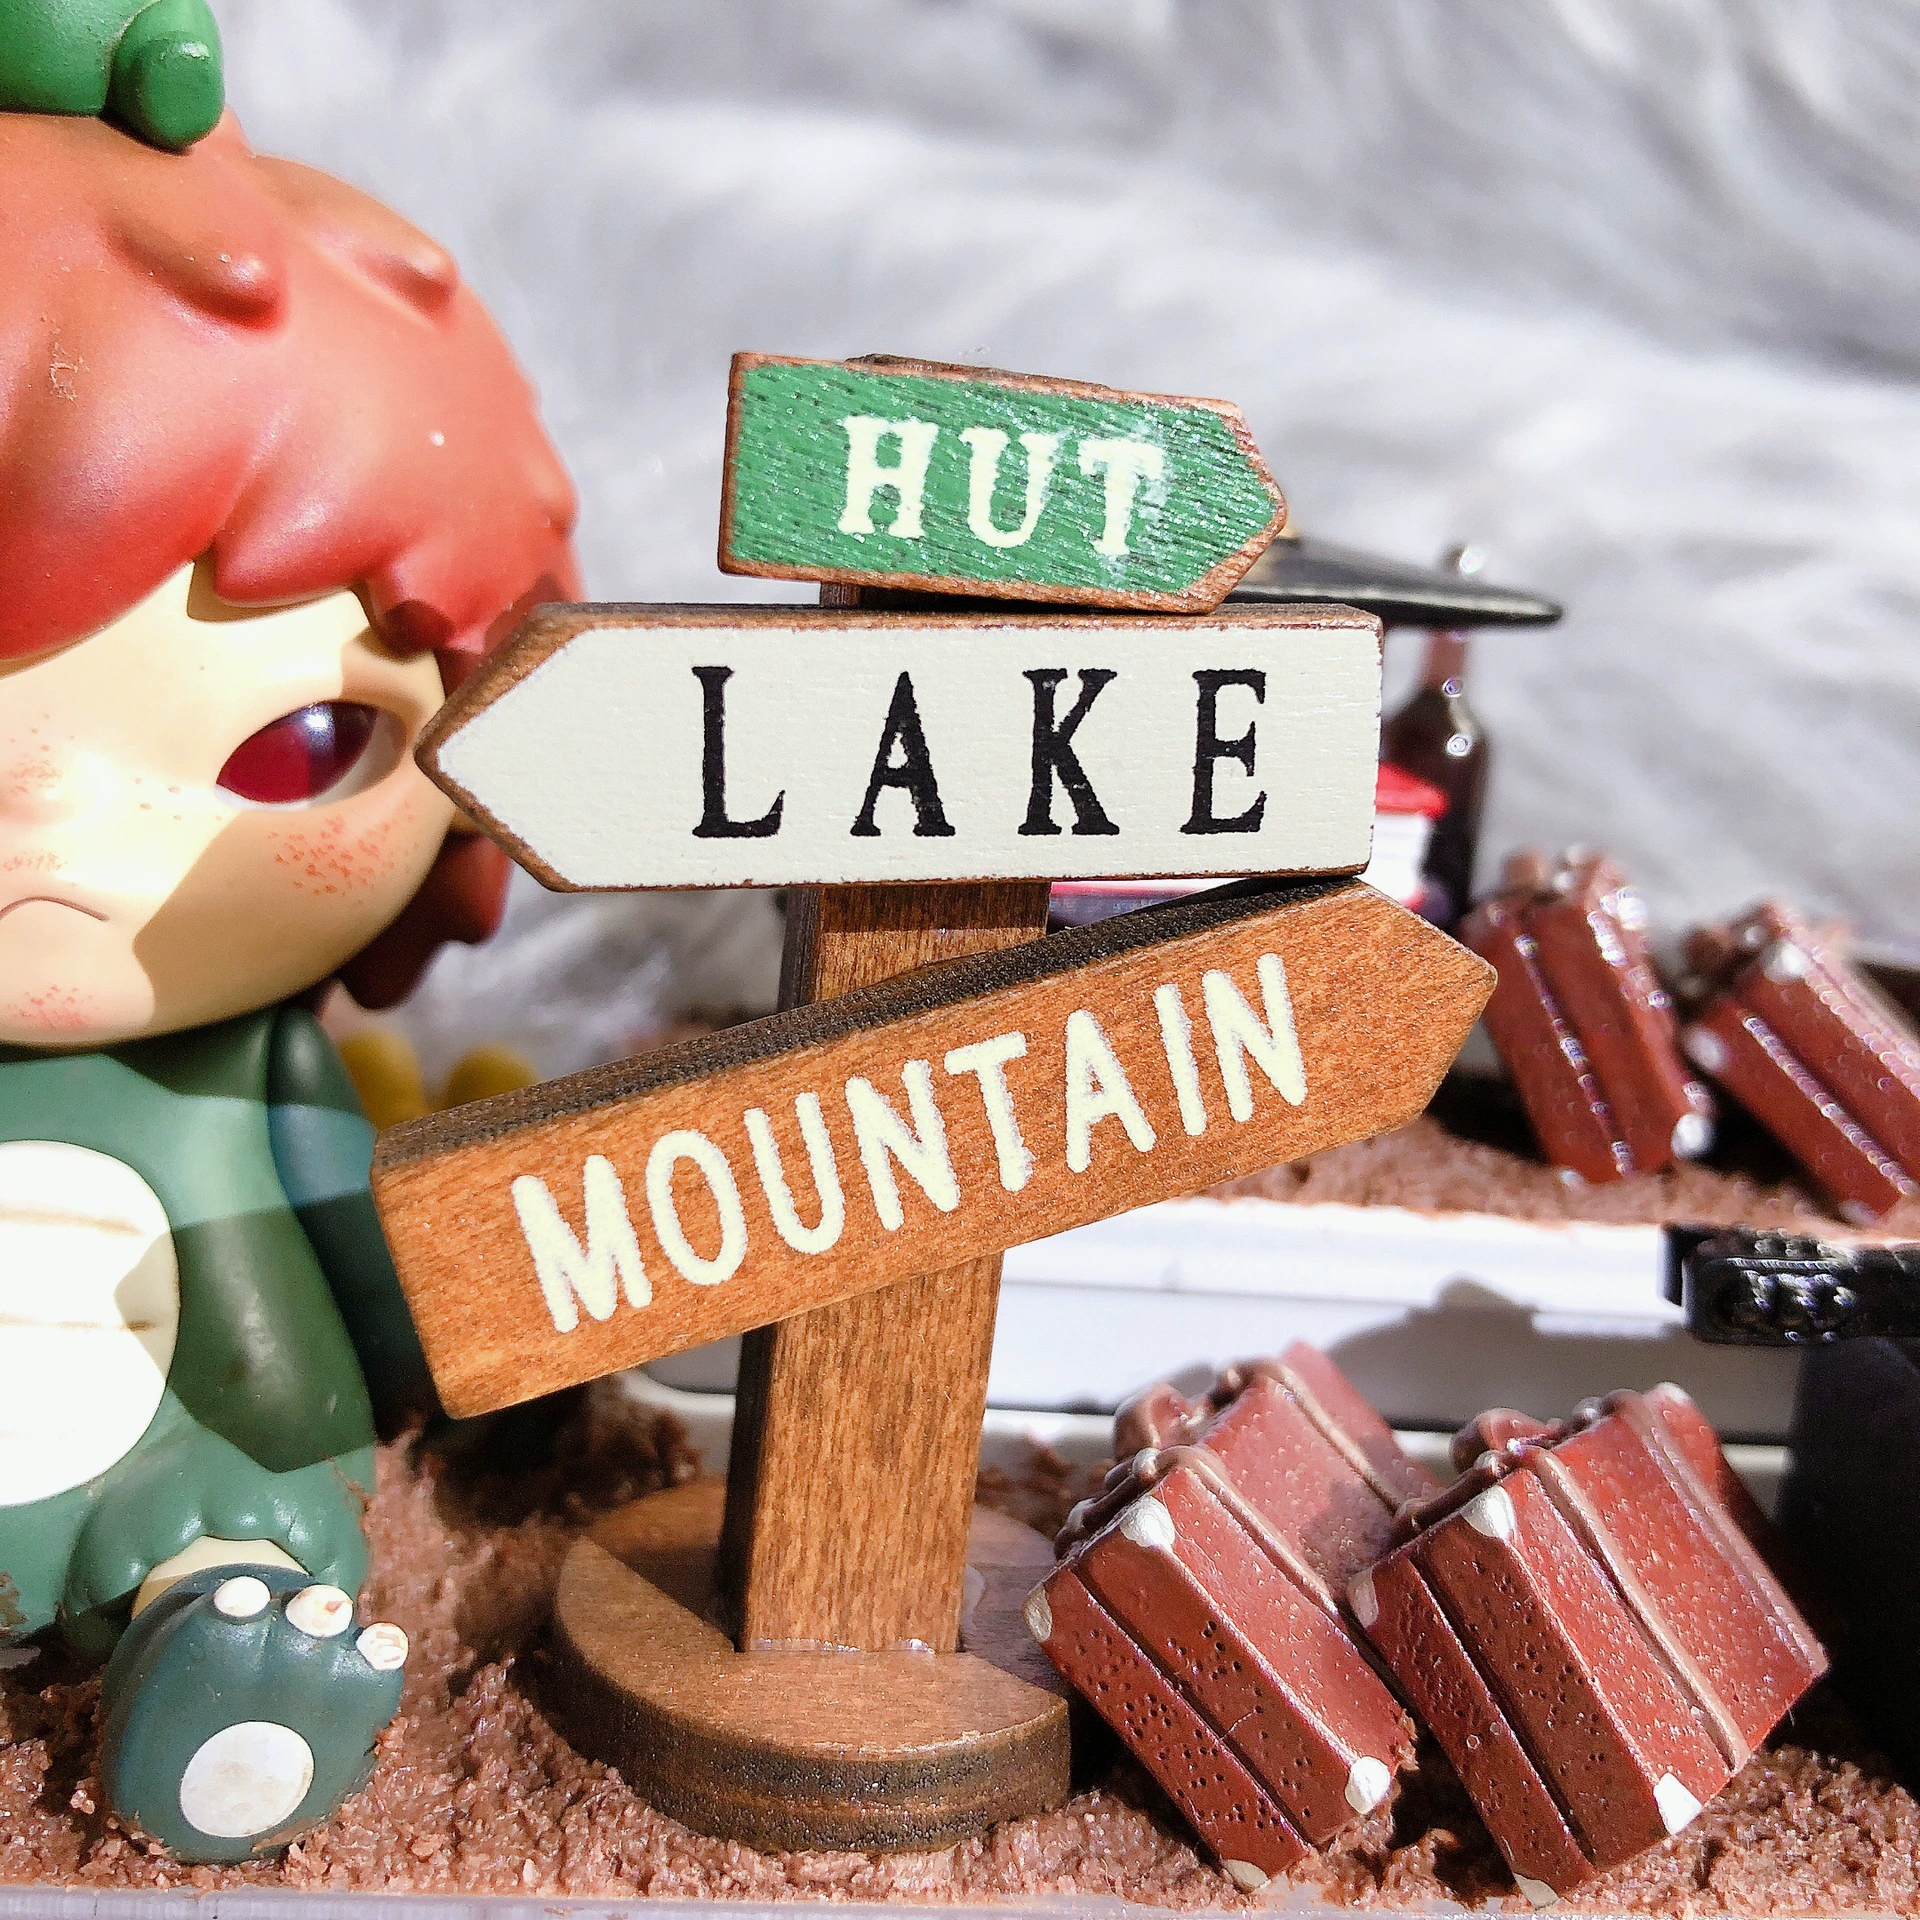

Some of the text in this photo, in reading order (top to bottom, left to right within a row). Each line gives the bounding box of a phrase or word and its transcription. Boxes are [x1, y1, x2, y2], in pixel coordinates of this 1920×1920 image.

[838, 414, 1167, 558] HUT
[692, 665, 1268, 839] LAKE
[510, 952, 1308, 1334] MOUNTAIN
